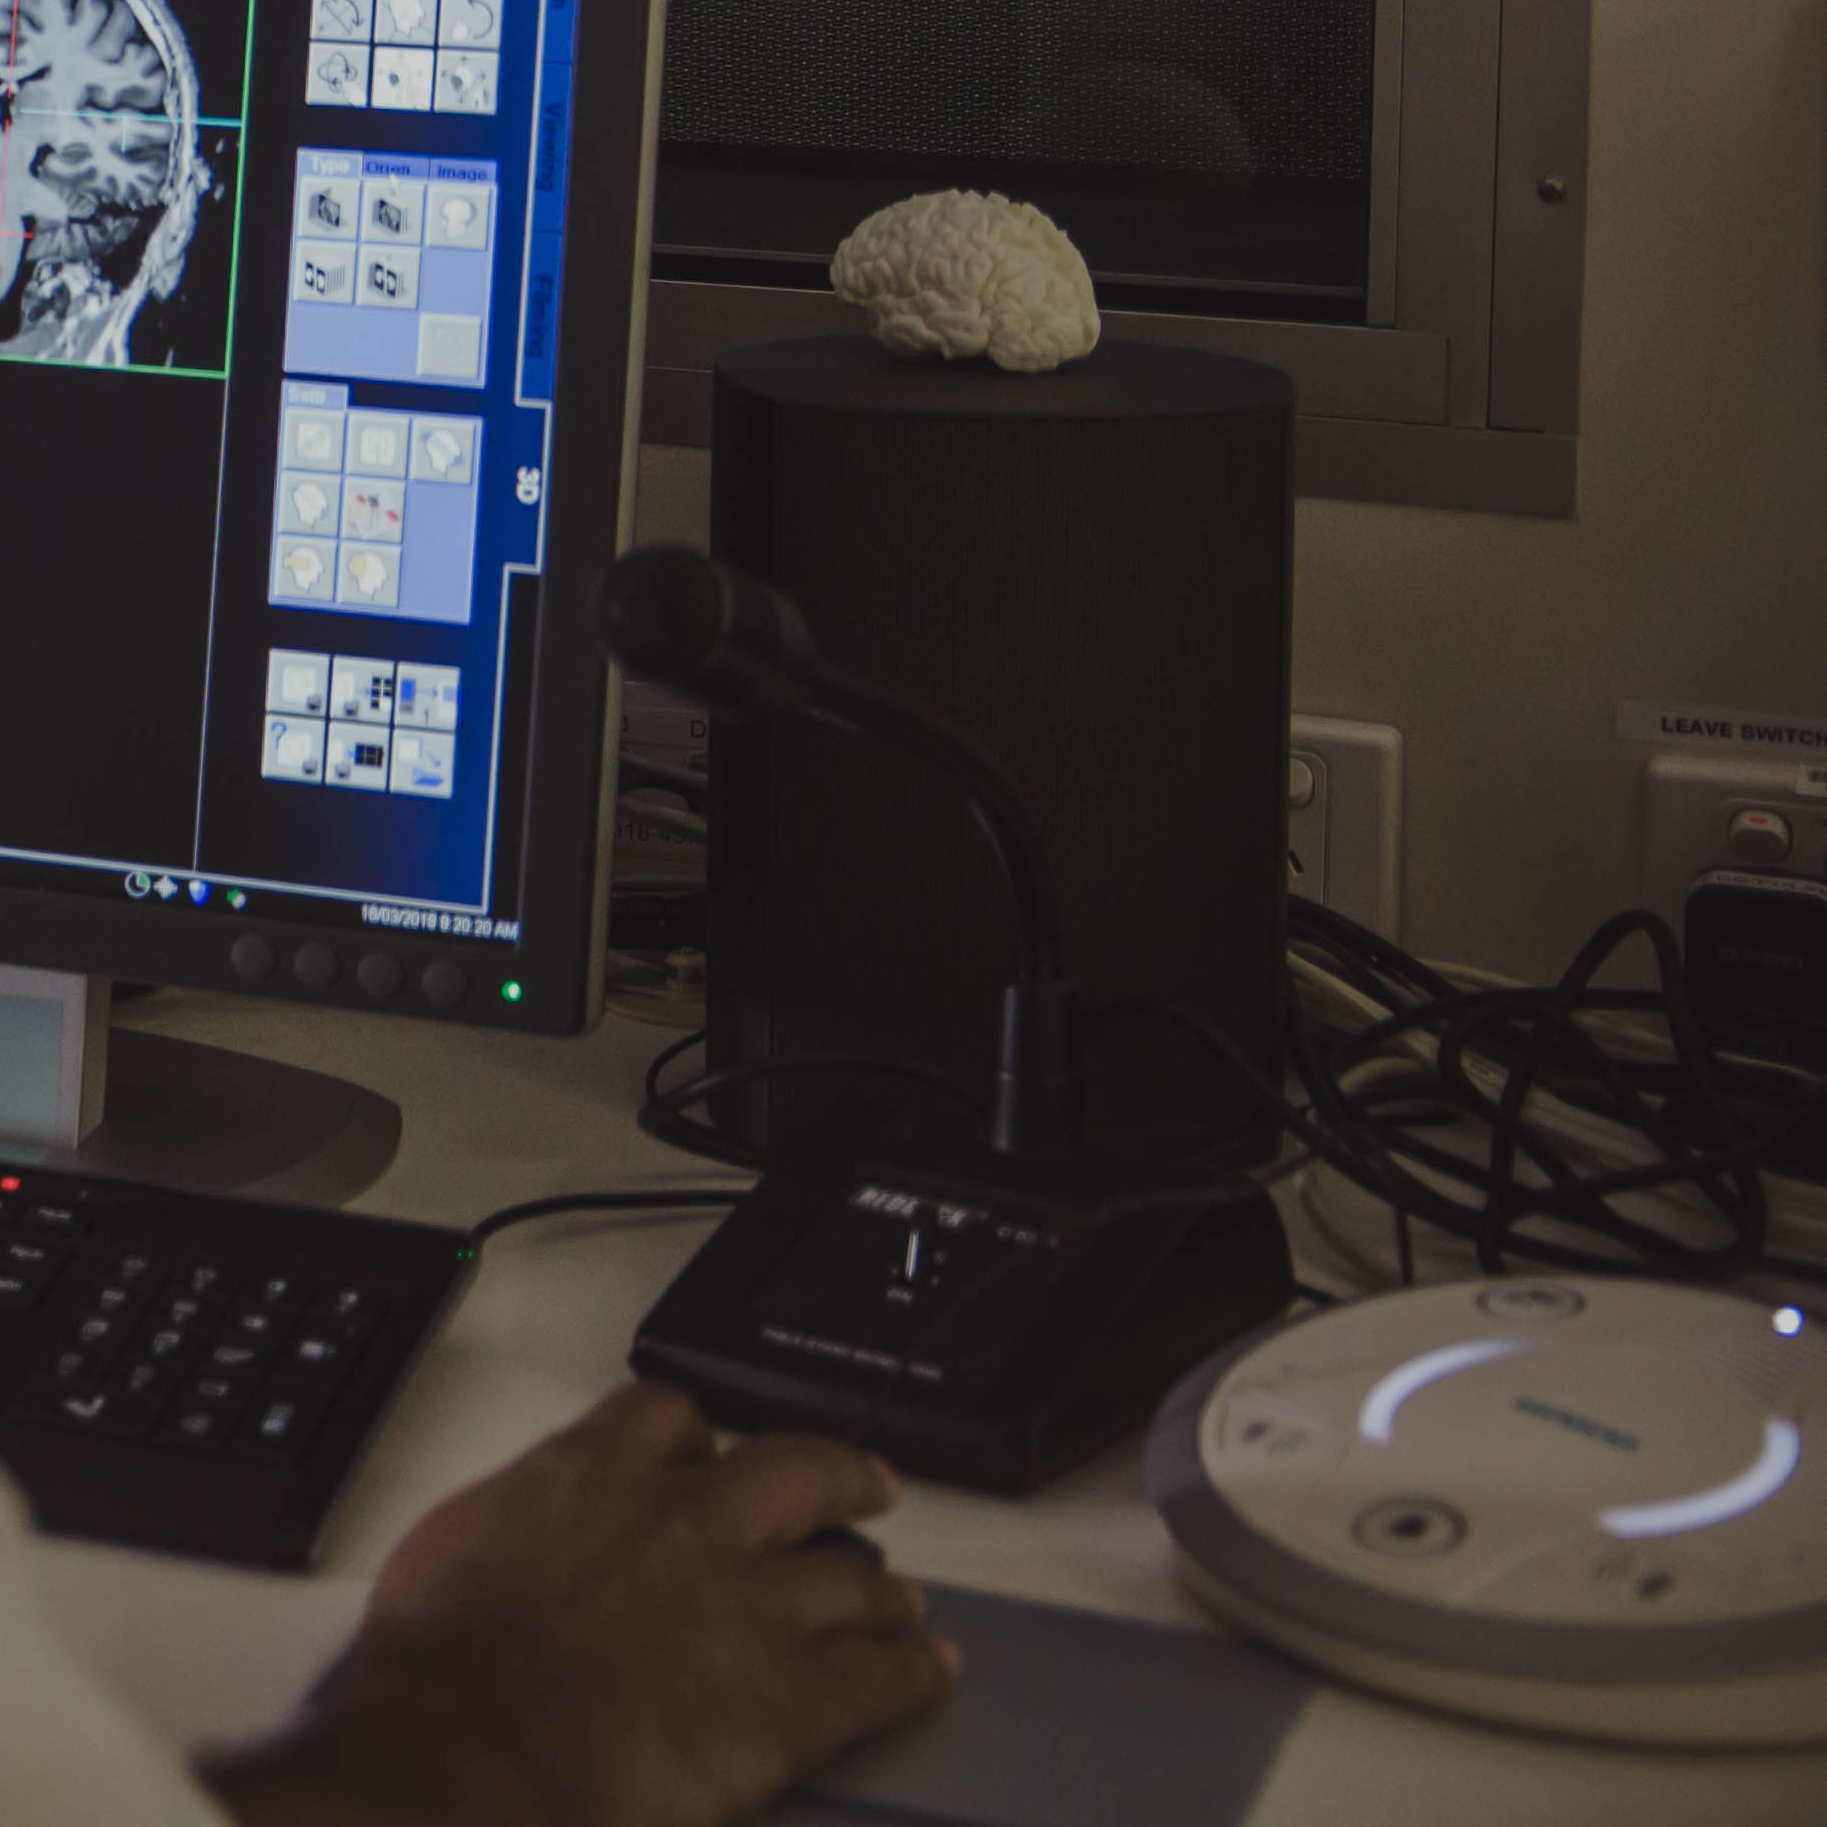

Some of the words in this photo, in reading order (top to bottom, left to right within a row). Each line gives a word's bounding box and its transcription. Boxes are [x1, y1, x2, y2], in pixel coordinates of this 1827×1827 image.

[515, 465, 541, 506] 3D
[1660, 716, 1733, 739] LEAVE
[495, 919, 520, 941] AM
